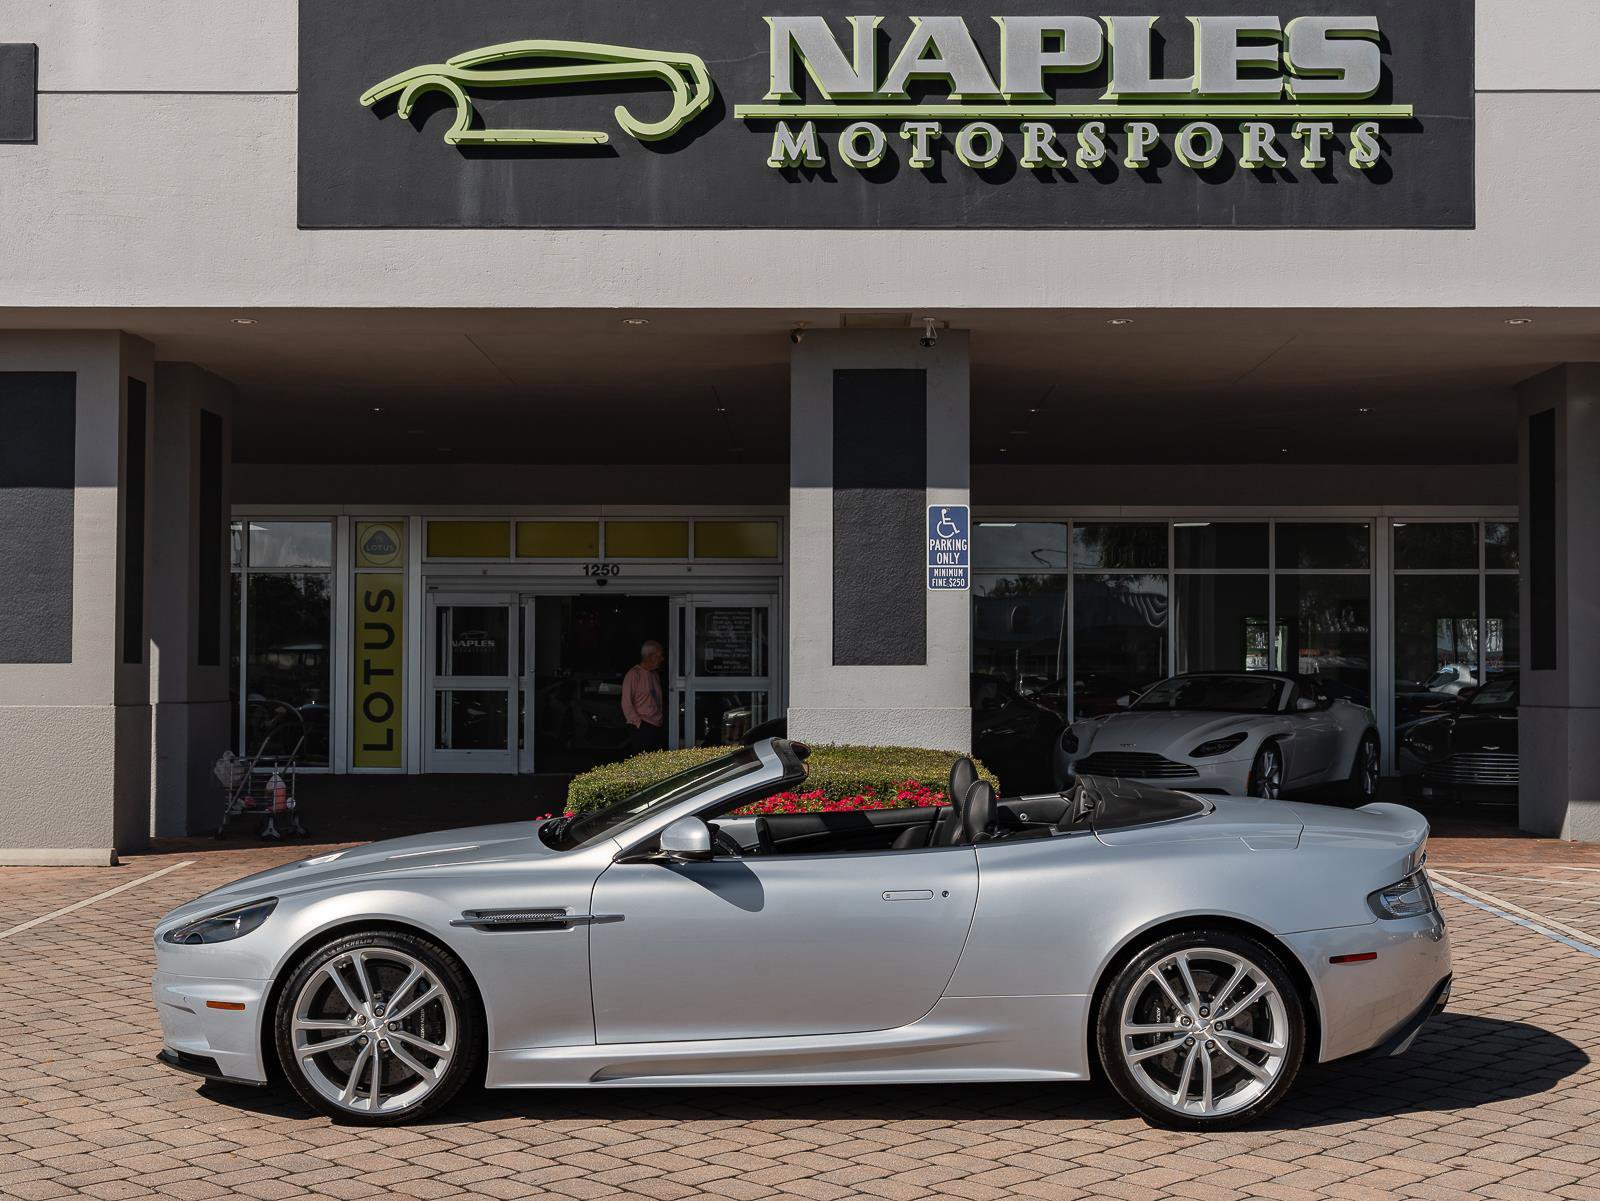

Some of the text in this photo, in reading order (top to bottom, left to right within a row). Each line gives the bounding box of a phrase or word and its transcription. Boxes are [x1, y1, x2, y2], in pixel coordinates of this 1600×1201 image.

[763, 15, 1381, 101] NAPLES
[767, 121, 1381, 168] MOTORSPORTS
[929, 539, 967, 551] PARKING
[937, 552, 960, 565] ONLY
[583, 563, 620, 576] 1250
[934, 568, 963, 577] MINIMUM
[932, 578, 965, 587] FINE $250
[453, 639, 496, 648] NAPLES
[363, 589, 395, 751] LOTUS
